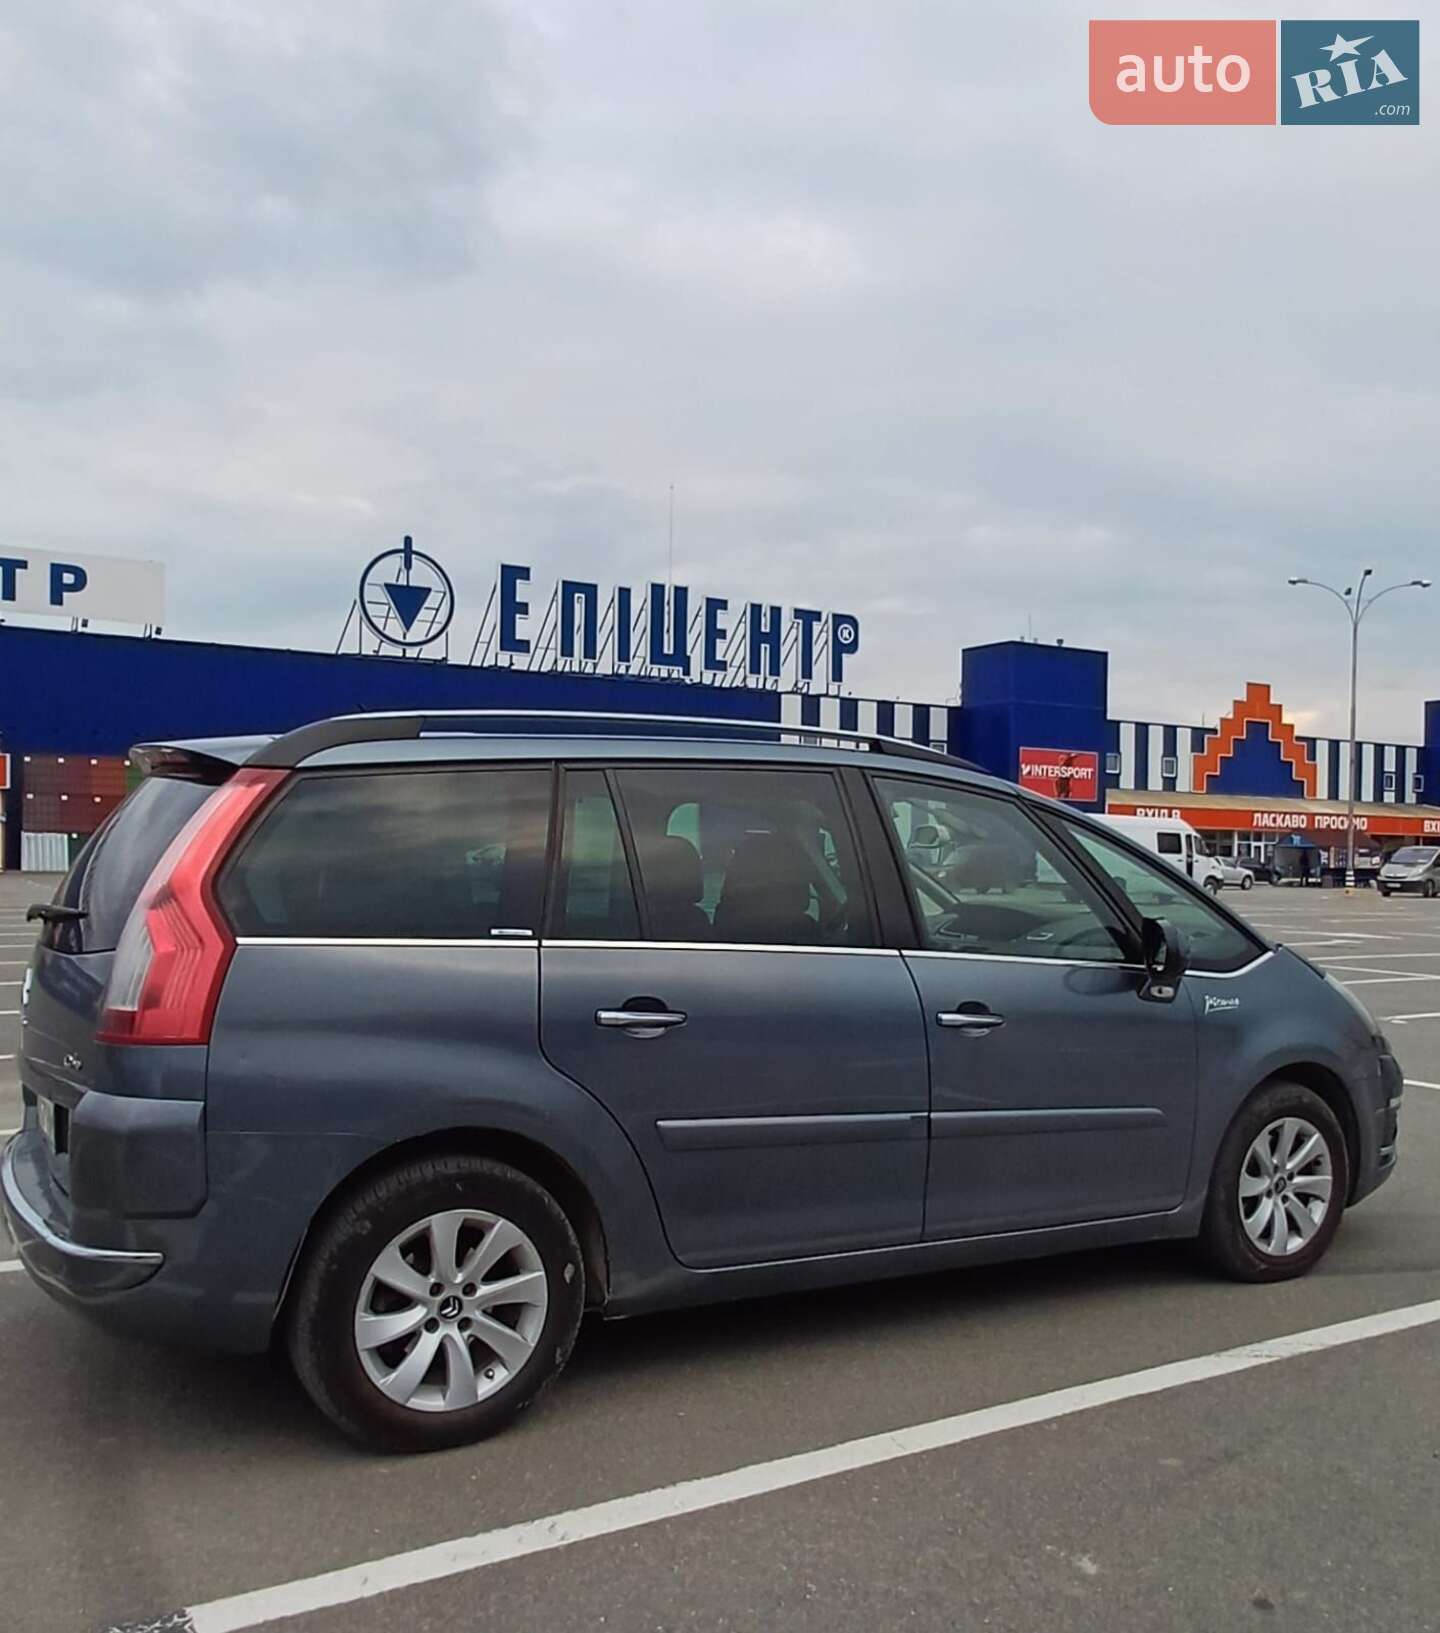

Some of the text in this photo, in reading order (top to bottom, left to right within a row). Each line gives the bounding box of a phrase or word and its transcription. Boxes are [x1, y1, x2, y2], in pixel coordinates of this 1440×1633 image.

[499, 563, 859, 684] ЕПІЦЕНТР
[1031, 764, 1094, 779] INTERSPORT
[1252, 812, 1308, 828] ЛАСКАВО
